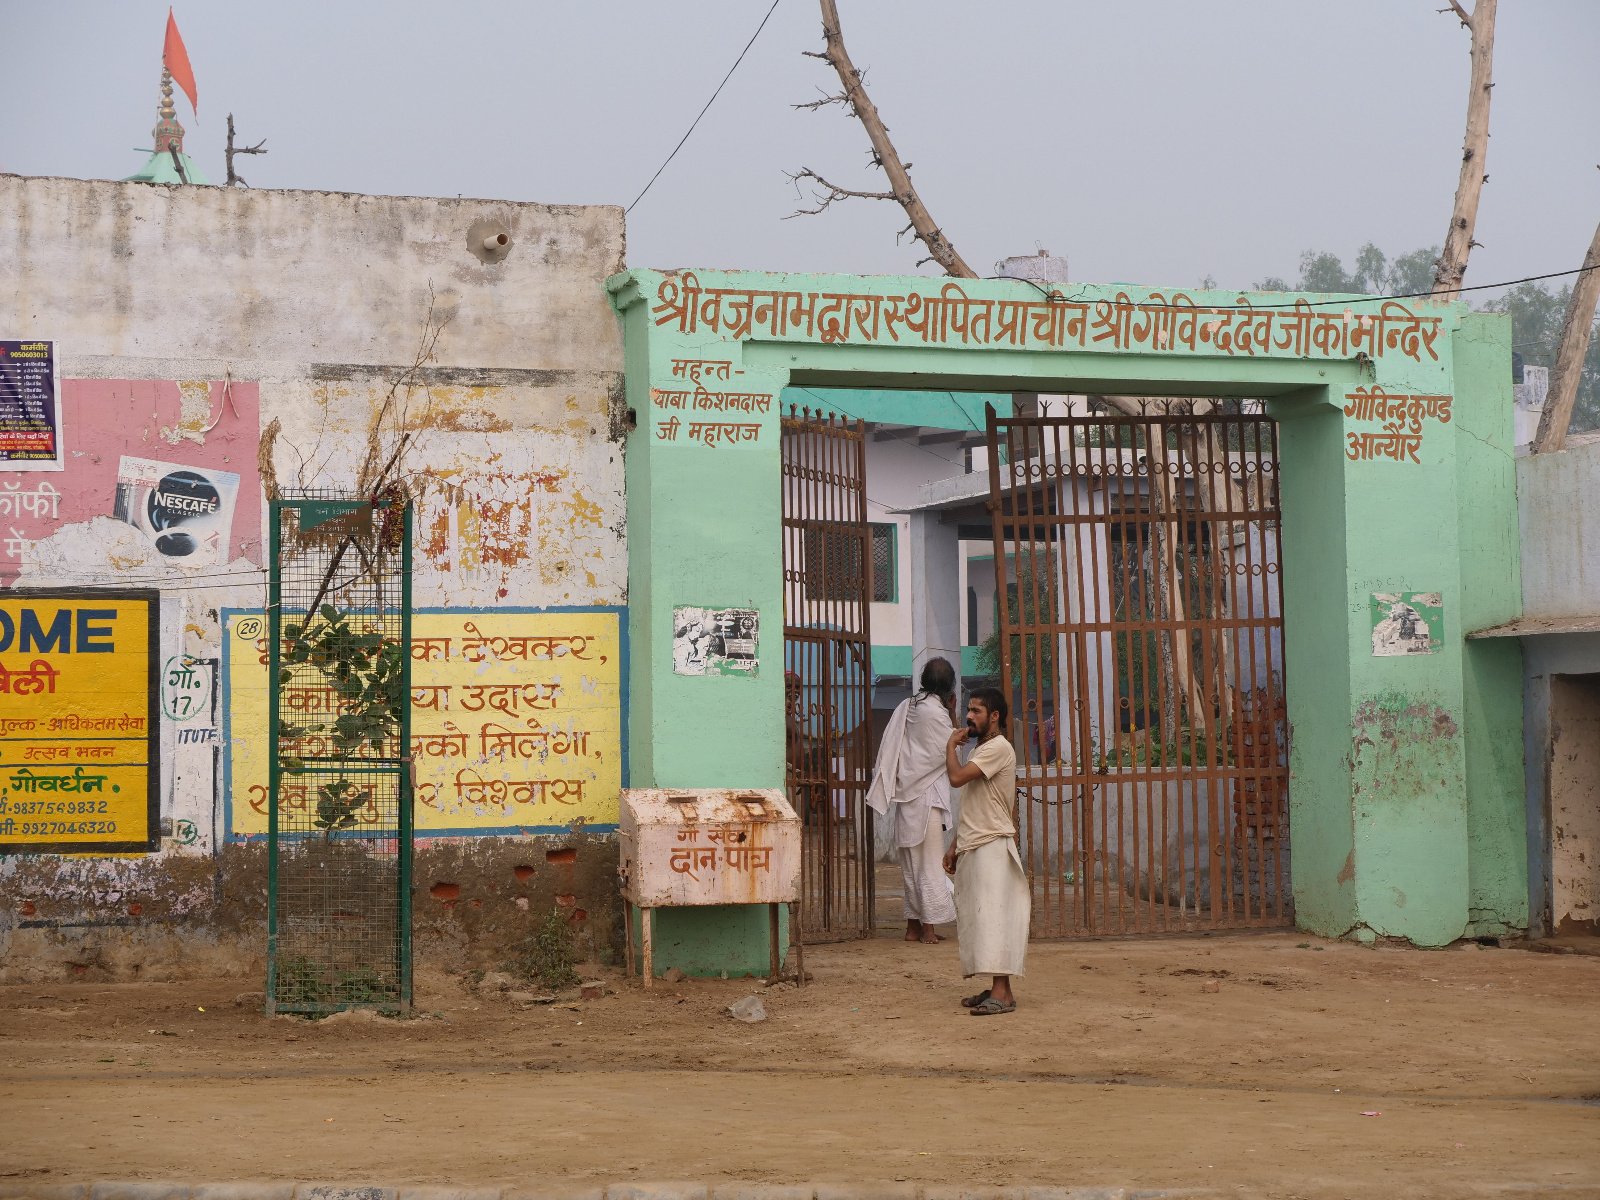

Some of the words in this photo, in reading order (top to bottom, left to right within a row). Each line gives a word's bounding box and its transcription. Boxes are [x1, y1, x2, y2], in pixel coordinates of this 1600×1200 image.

[655, 415, 681, 441] जी
[688, 422, 762, 448] महाराज
[166, 508, 200, 518] CLASSIC
[239, 621, 259, 635] 28
[669, 846, 718, 882] दान
